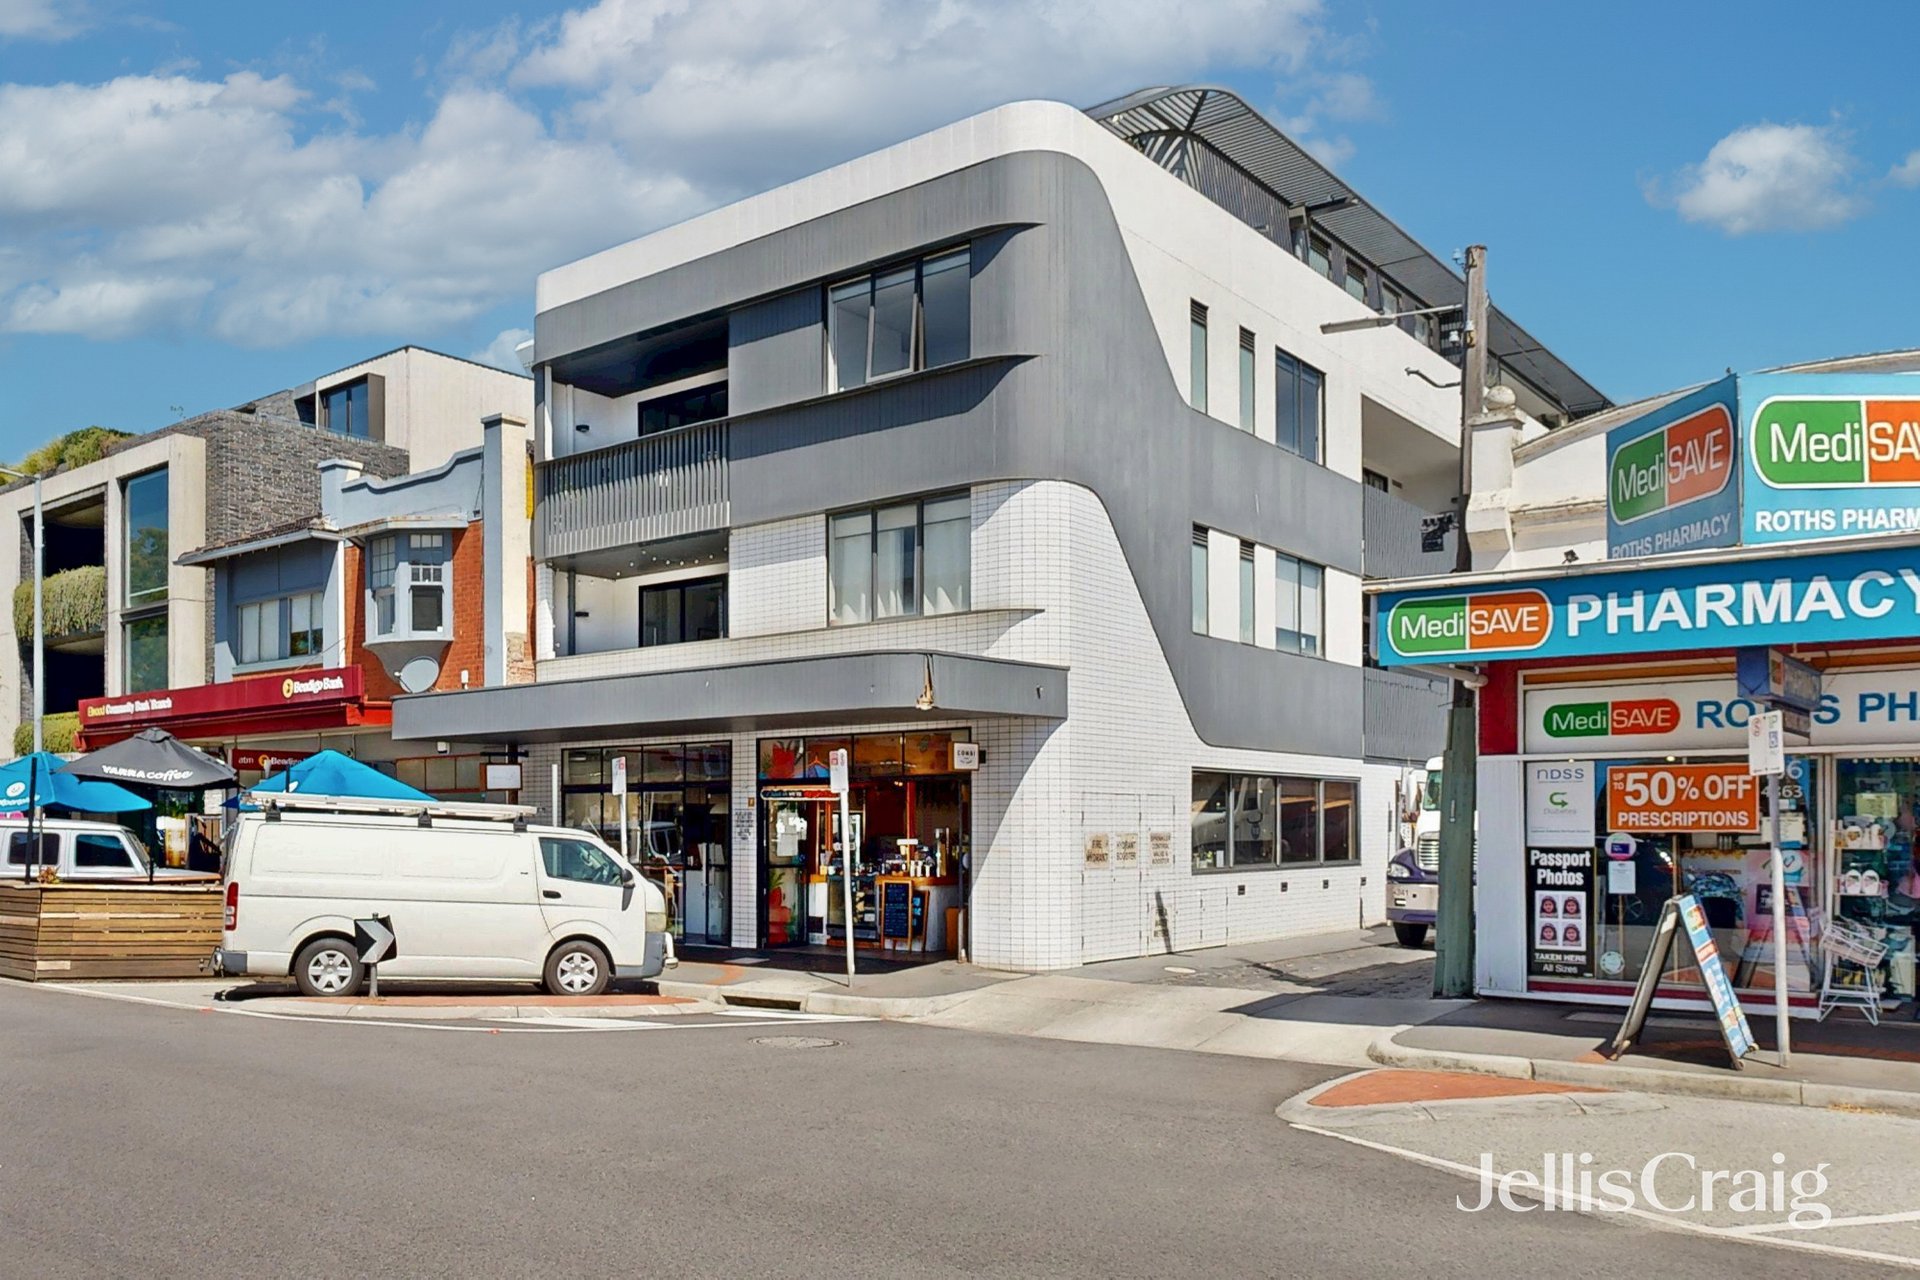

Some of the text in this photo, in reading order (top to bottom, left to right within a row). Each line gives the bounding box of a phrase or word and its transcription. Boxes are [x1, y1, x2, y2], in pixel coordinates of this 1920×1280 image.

[1755, 509, 1836, 532] ROTHS
[1655, 513, 1732, 552] PHARMACY
[293, 676, 344, 694] Bendigo Bank
[1696, 694, 1841, 729] ROS
[1858, 691, 1920, 723] PH
[1612, 773, 1625, 781] UP
[1613, 782, 1624, 790] TO
[1624, 771, 1752, 807] 50% OFF
[1617, 811, 1749, 827] PRESCRIPTIONS
[1530, 850, 1591, 869] Passport
[1537, 869, 1584, 886] Photos
[1534, 952, 1587, 962] TAKEN HERE
[1543, 963, 1578, 974] All Sizes
